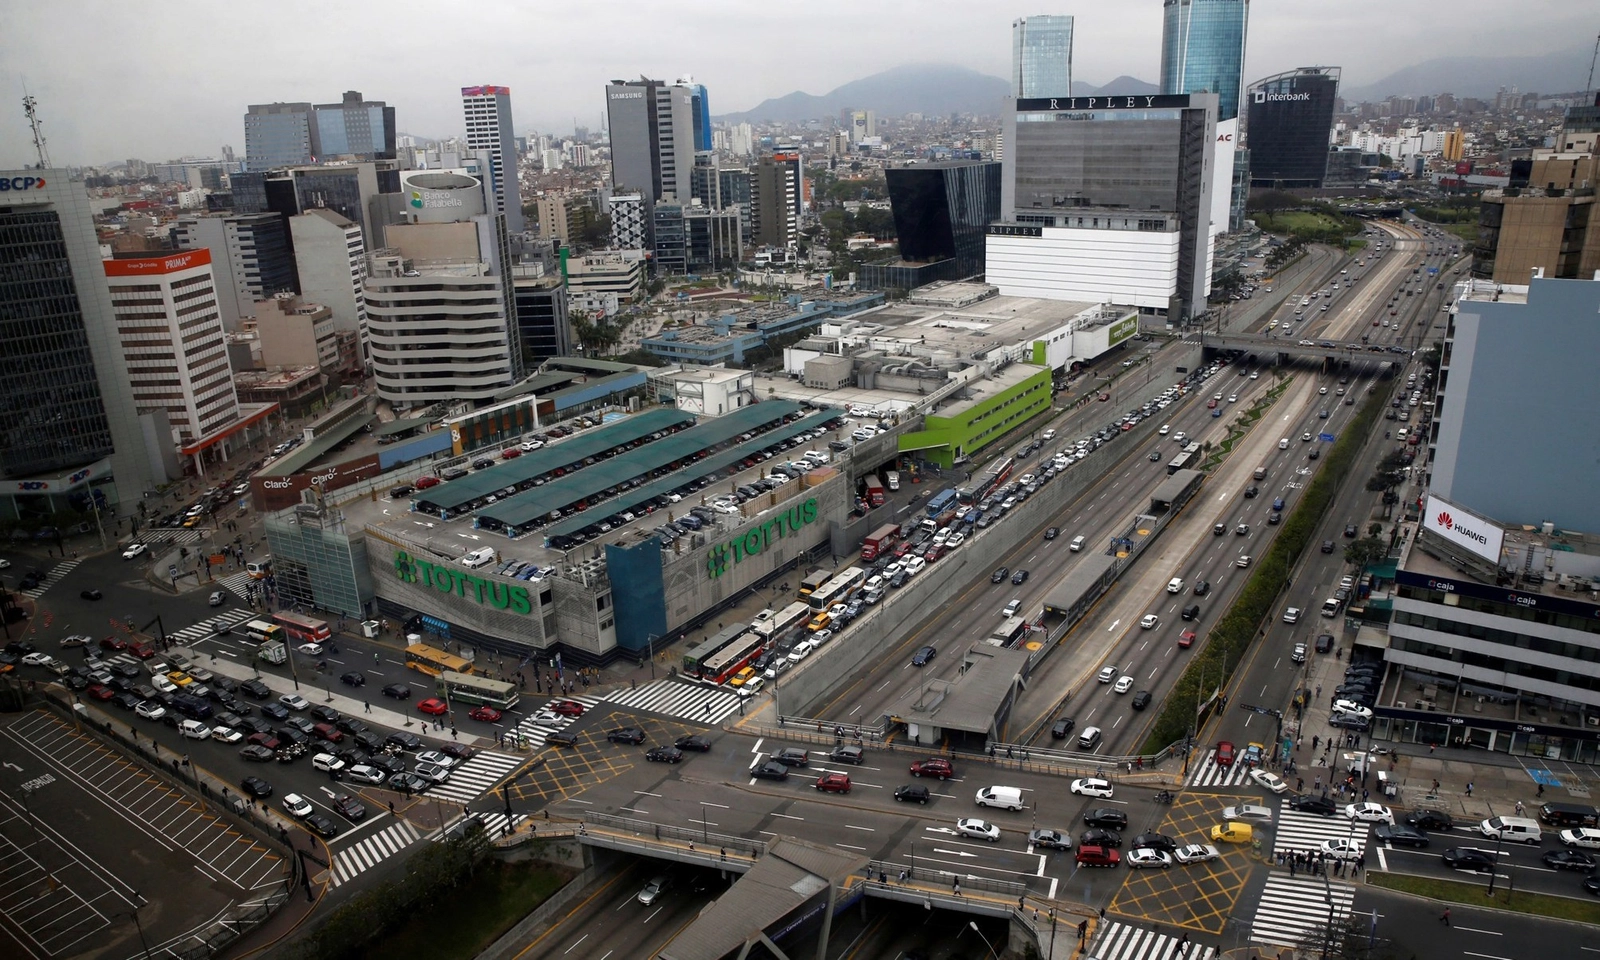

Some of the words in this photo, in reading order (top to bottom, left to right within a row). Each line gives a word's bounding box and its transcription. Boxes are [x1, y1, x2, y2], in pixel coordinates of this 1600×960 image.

[1267, 92, 1310, 101] Interbank
[1050, 96, 1154, 109] RIPLEY
[0, 177, 35, 191] BCP
[424, 192, 450, 200] Banco
[425, 199, 462, 208] Falabella
[991, 226, 1037, 235] RIPLEY
[165, 257, 186, 269] PRIMA
[264, 479, 289, 488] Claro
[311, 472, 335, 485] Claro
[729, 498, 817, 563] TOTTUS
[1454, 524, 1487, 545] HUAWEI
[416, 559, 531, 615] TOTTUS
[1436, 582, 1455, 591] caja
[1516, 597, 1536, 606] caja
